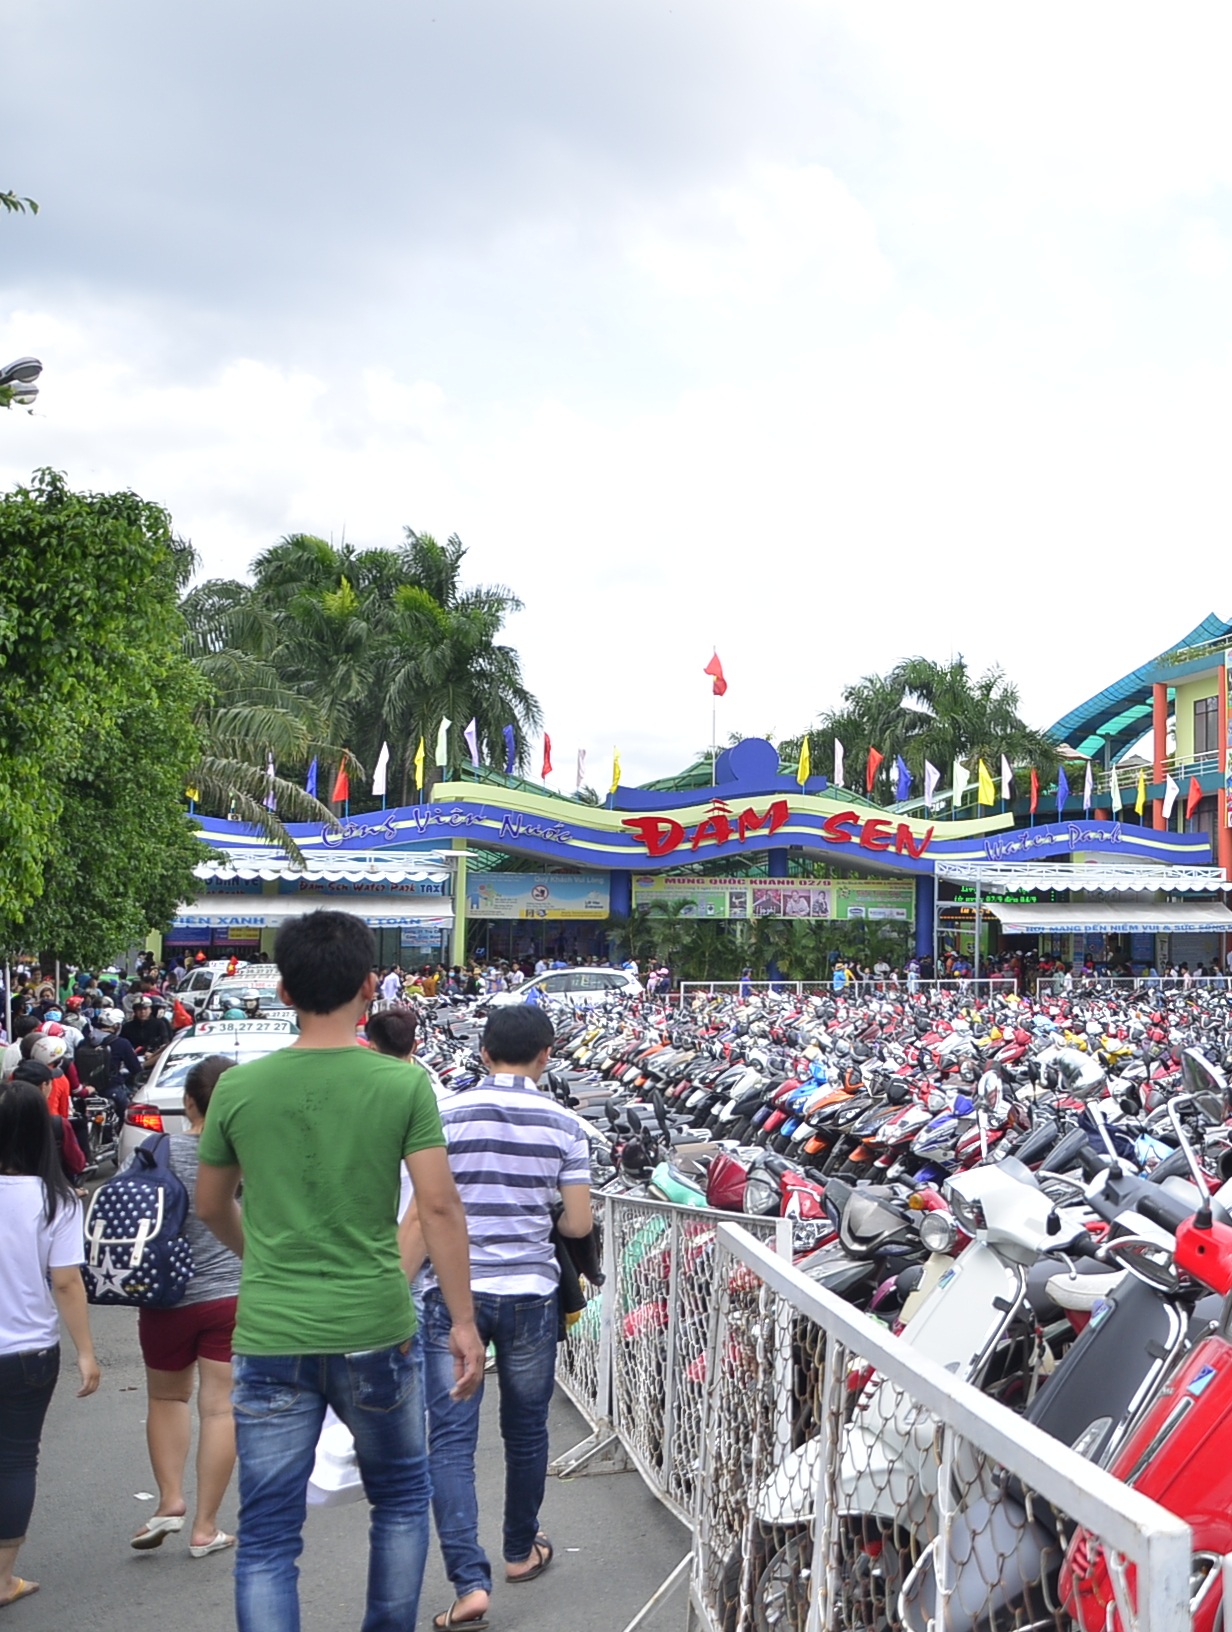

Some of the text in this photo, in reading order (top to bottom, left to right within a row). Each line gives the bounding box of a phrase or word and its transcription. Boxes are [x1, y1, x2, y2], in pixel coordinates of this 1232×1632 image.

[321, 814, 397, 848] Công
[412, 807, 488, 834] Viên
[621, 798, 935, 860] ĐẦM SEN
[983, 820, 1123, 862] Water Park
[216, 916, 265, 925] XANH
[256, 1023, 271, 1031] 27
[273, 1023, 288, 1031] 27
